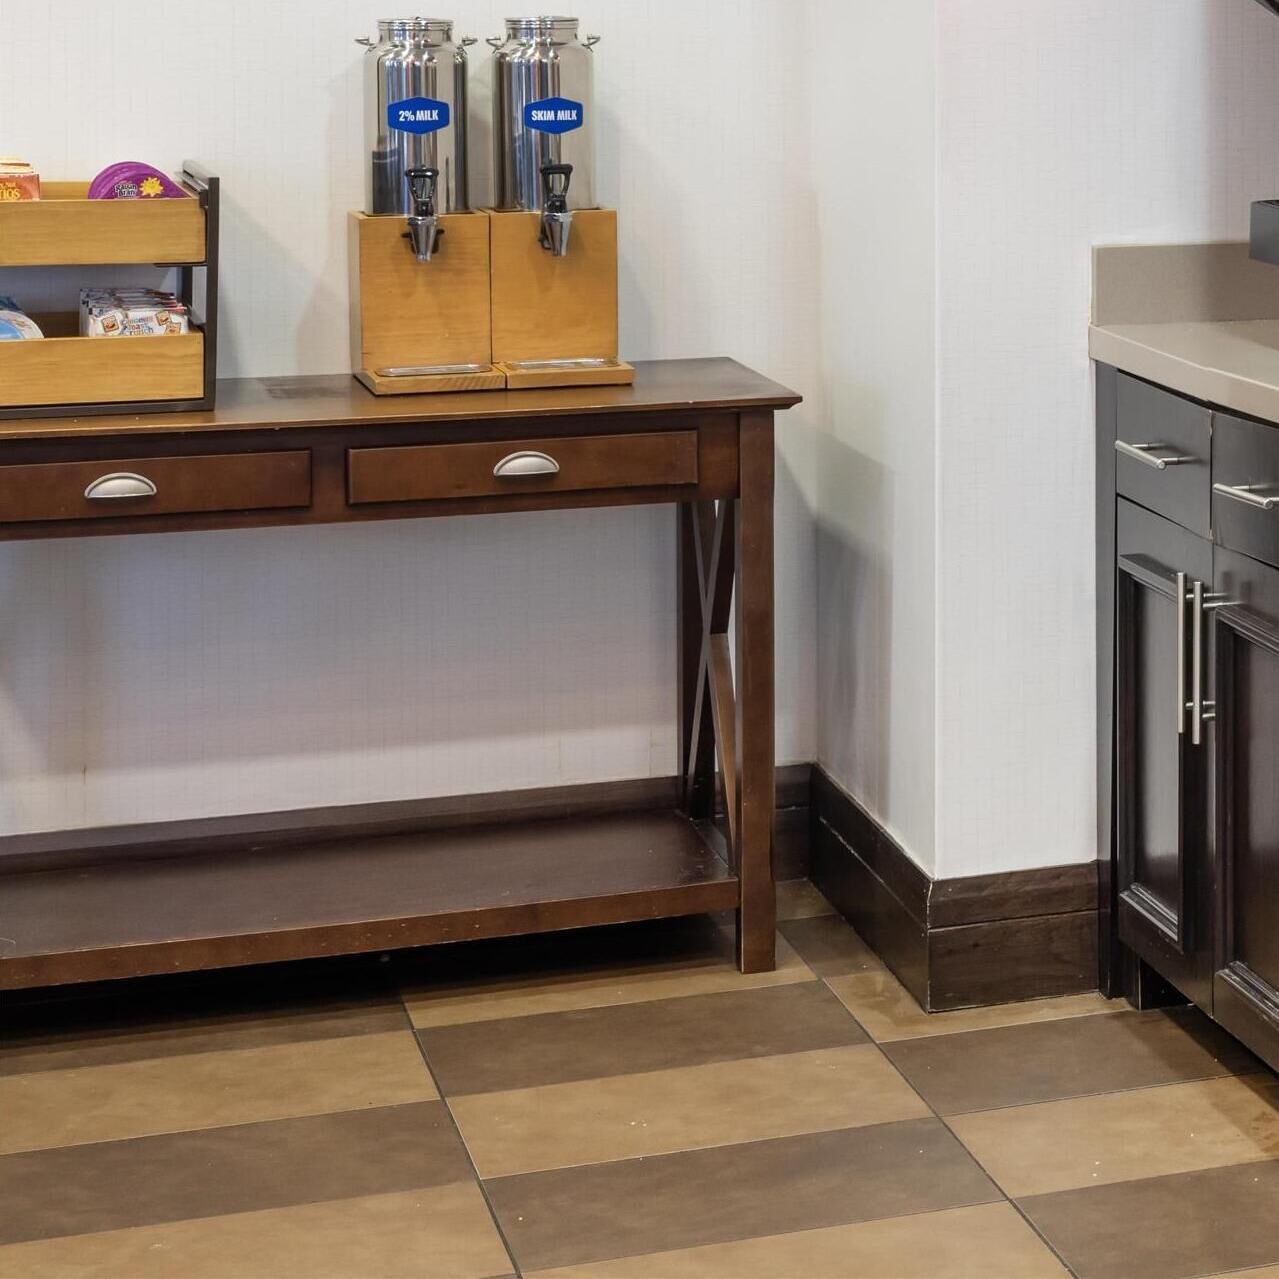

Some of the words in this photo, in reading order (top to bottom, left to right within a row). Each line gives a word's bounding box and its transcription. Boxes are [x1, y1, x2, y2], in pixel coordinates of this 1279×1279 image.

[398, 110, 415, 122] 2%
[416, 109, 439, 121] MILK
[531, 109, 555, 121] SKIM
[556, 109, 577, 121] MILK
